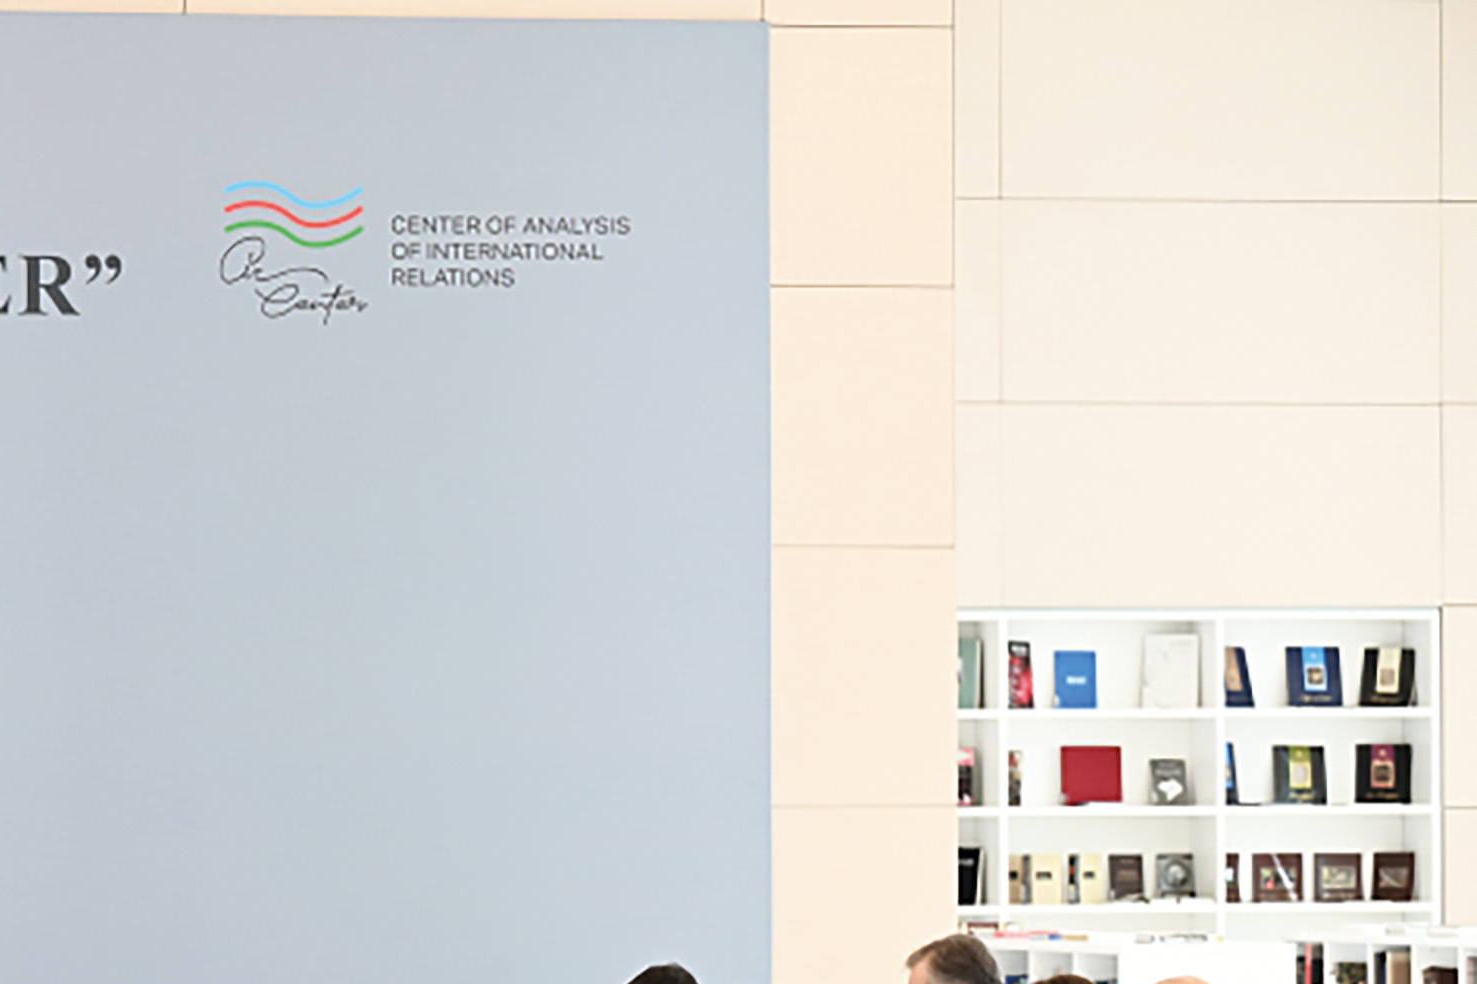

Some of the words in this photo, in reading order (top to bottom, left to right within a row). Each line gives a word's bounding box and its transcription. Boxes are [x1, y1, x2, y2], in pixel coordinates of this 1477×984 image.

[391, 214, 481, 236] CENTER
[485, 214, 516, 236] OF
[523, 216, 631, 236] ANALYSIS
[391, 242, 421, 261] OF
[426, 242, 604, 261] INTERNATIONAL
[391, 267, 516, 288] RELATIONS
